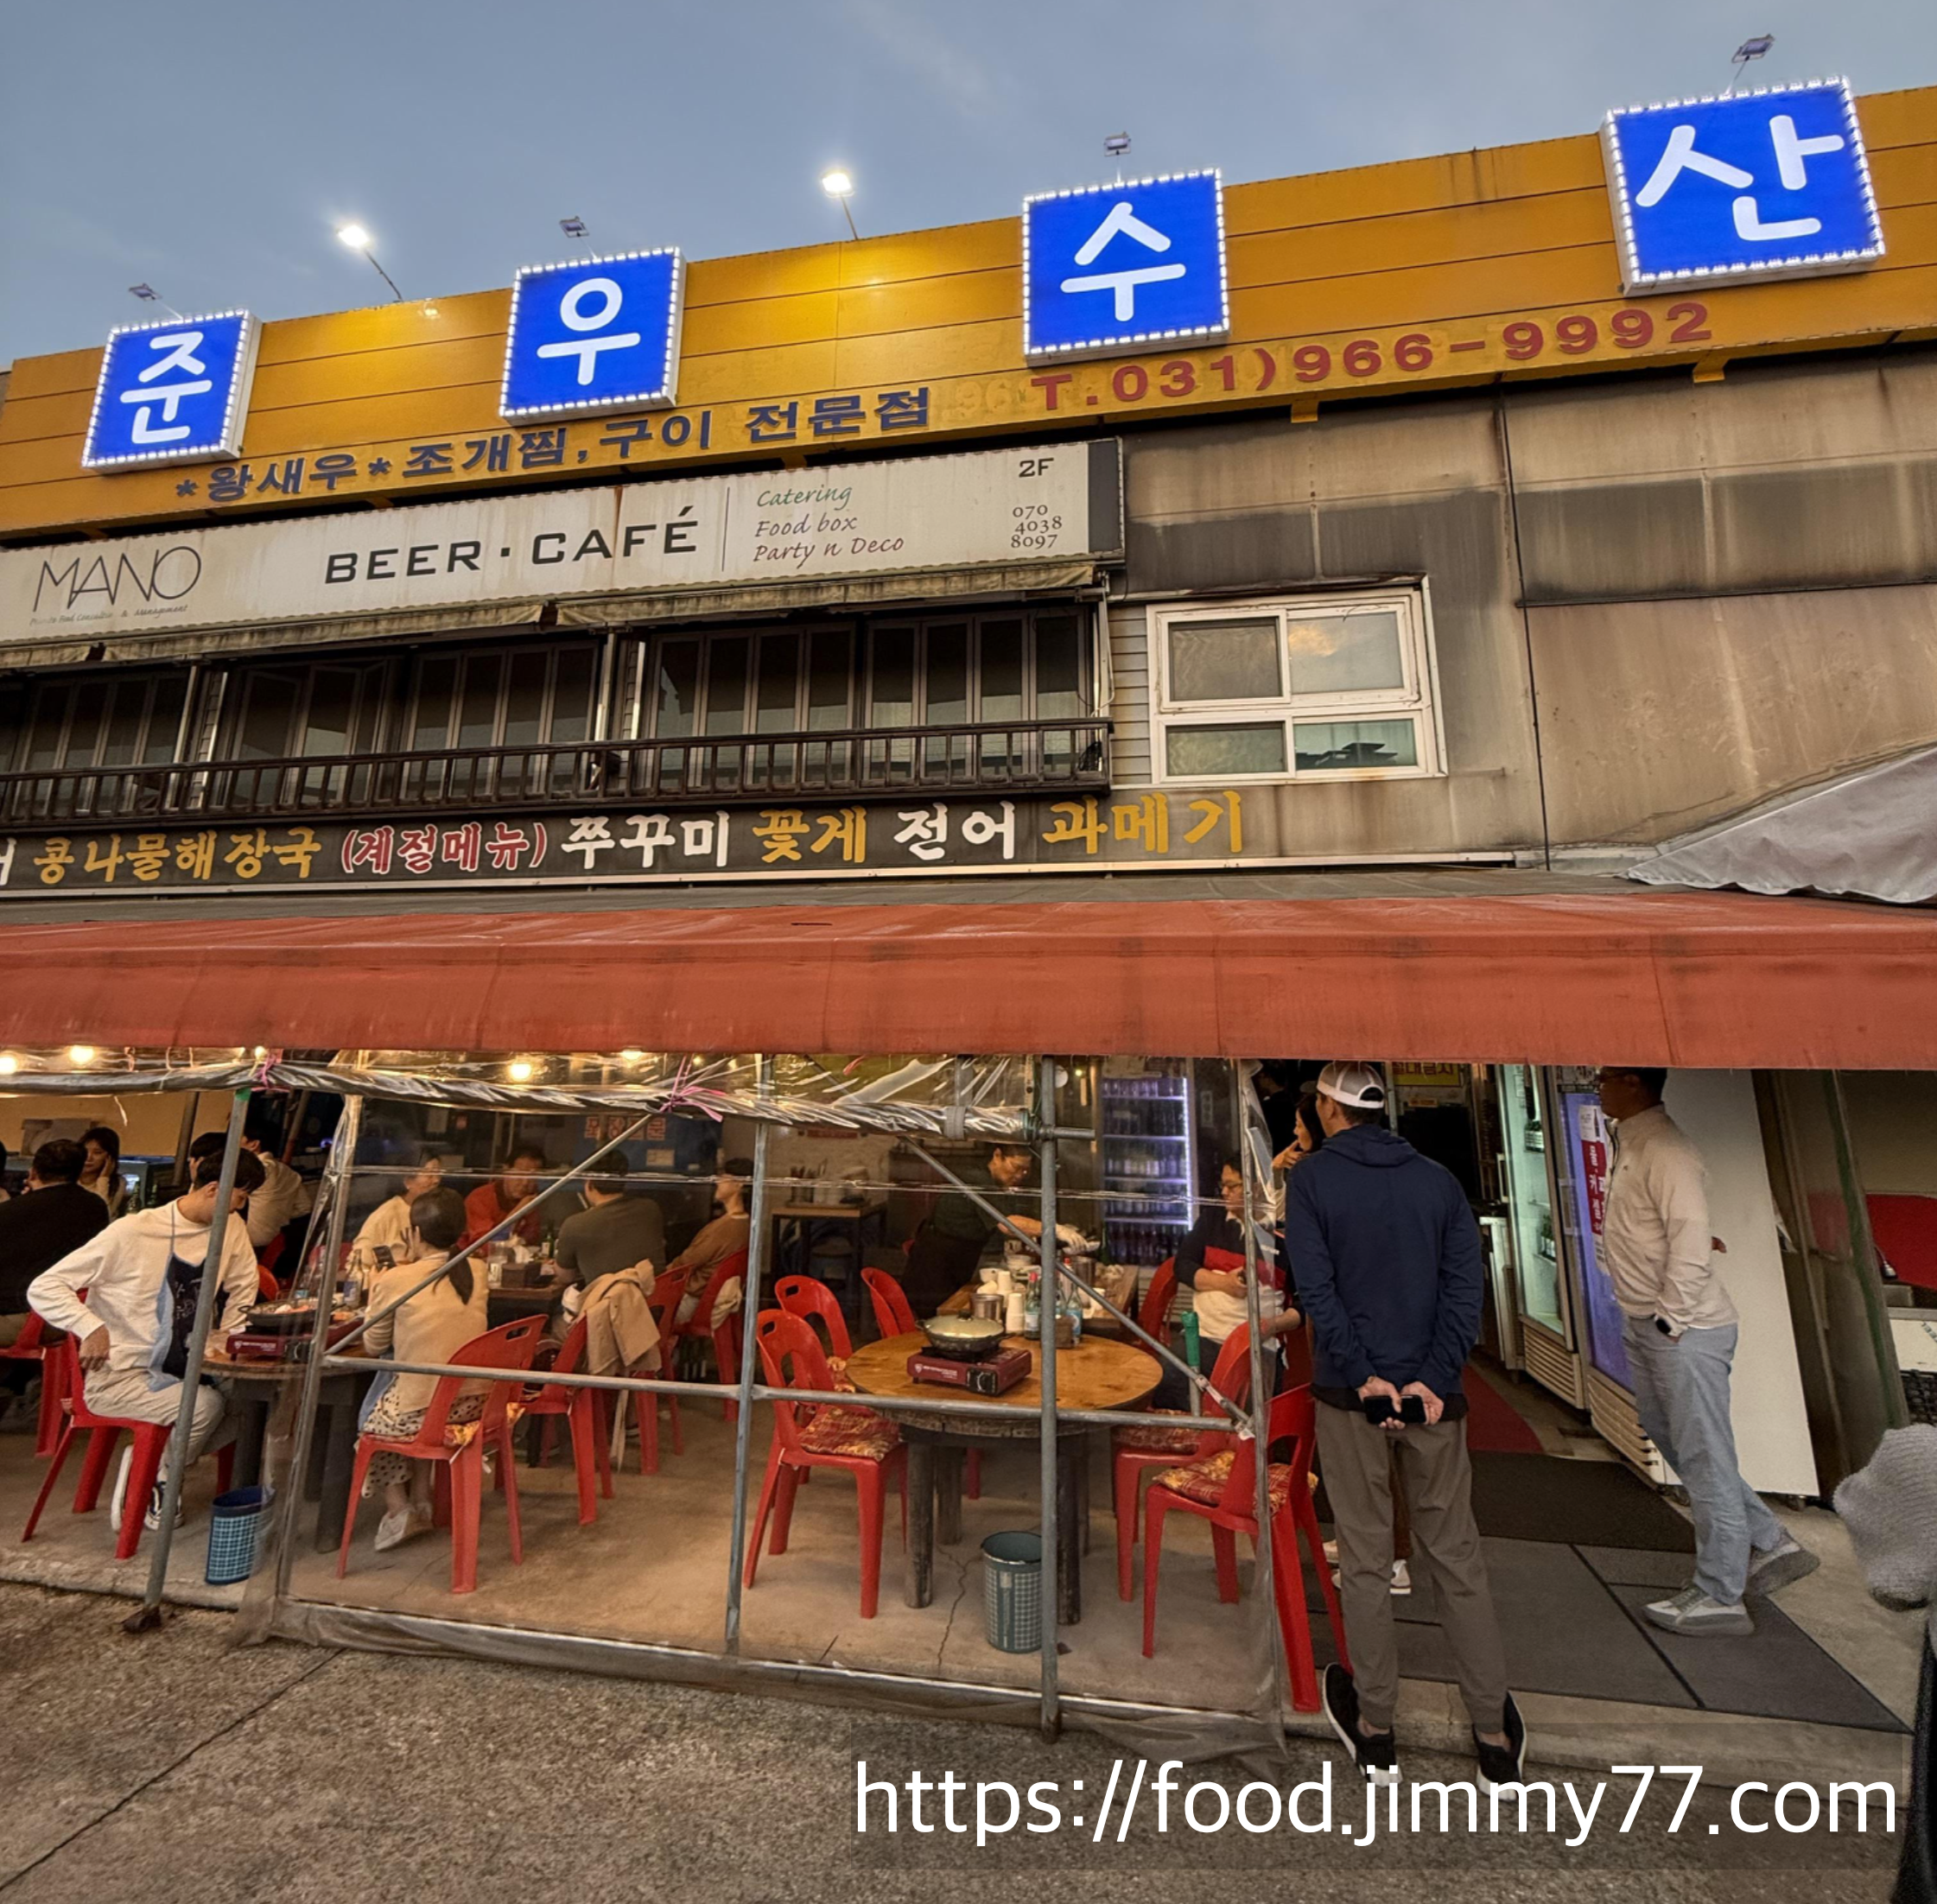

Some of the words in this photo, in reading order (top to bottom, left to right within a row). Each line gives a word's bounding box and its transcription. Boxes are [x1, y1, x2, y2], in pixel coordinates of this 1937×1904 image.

[119, 330, 213, 445] 준
[537, 277, 641, 386] 우
[1059, 201, 1187, 322] 수
[1635, 114, 1845, 242] 산
[745, 386, 930, 443] 전문점
[1019, 457, 1055, 478] 2F
[757, 484, 853, 511] Catering
[754, 513, 811, 537] Food
[817, 512, 858, 533] box
[1012, 505, 1048, 520] 070
[1014, 515, 1063, 536] 4038
[531, 505, 699, 565] CAFÉ
[1010, 534, 1058, 550] 8097
[753, 542, 816, 569] Party
[823, 543, 842, 556] n
[851, 537, 905, 555] Deco
[32, 545, 202, 612] MANO
[33, 825, 322, 885] 콩나물해장국
[560, 809, 731, 870] 쭈꾸미
[752, 804, 867, 864] 꽃게
[893, 800, 1016, 861] 전어
[1042, 790, 1242, 854] 과메기
